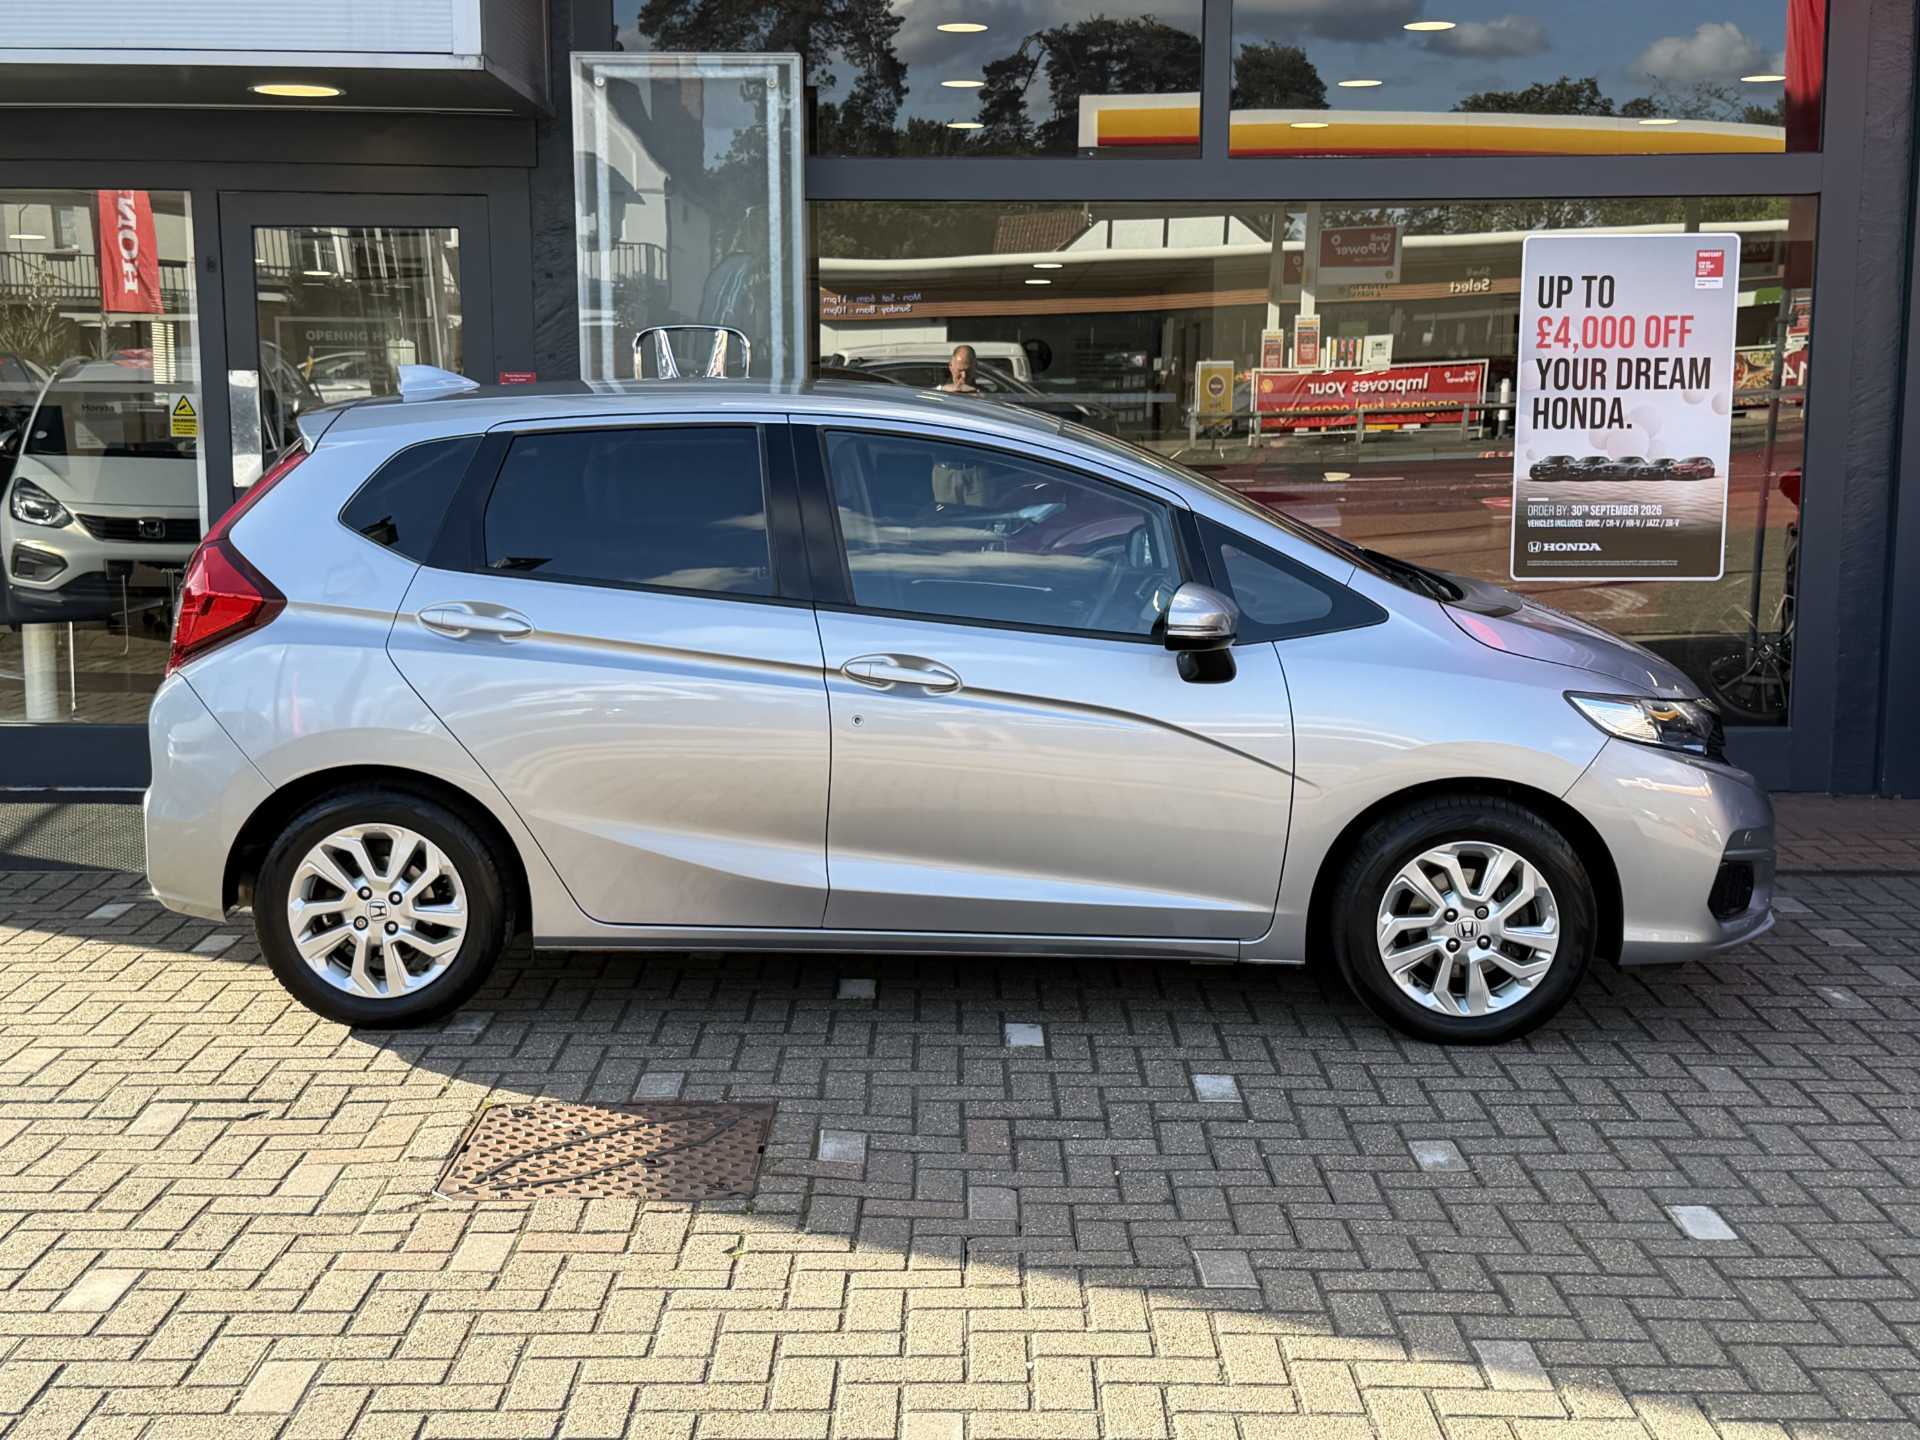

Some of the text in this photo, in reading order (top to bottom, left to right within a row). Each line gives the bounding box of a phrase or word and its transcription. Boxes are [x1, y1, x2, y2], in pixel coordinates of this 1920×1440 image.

[1537, 275, 1615, 309] UP TO
[305, 330, 368, 341] OPENING
[1536, 315, 1694, 353] £4,000 OFF
[1536, 357, 1711, 390] YOUR DREAM
[1532, 397, 1632, 430] HONDA.
[1528, 504, 1554, 516] ORDER
[1556, 504, 1570, 516] BY:
[1590, 504, 1639, 516] SEPTEMBER
[1641, 504, 1663, 516] 2026
[1528, 519, 1554, 528] VEHICLES
[1555, 519, 1584, 528] INCLUDED:
[1585, 519, 1600, 528] CIVIC
[1543, 542, 1602, 552] HONDA
